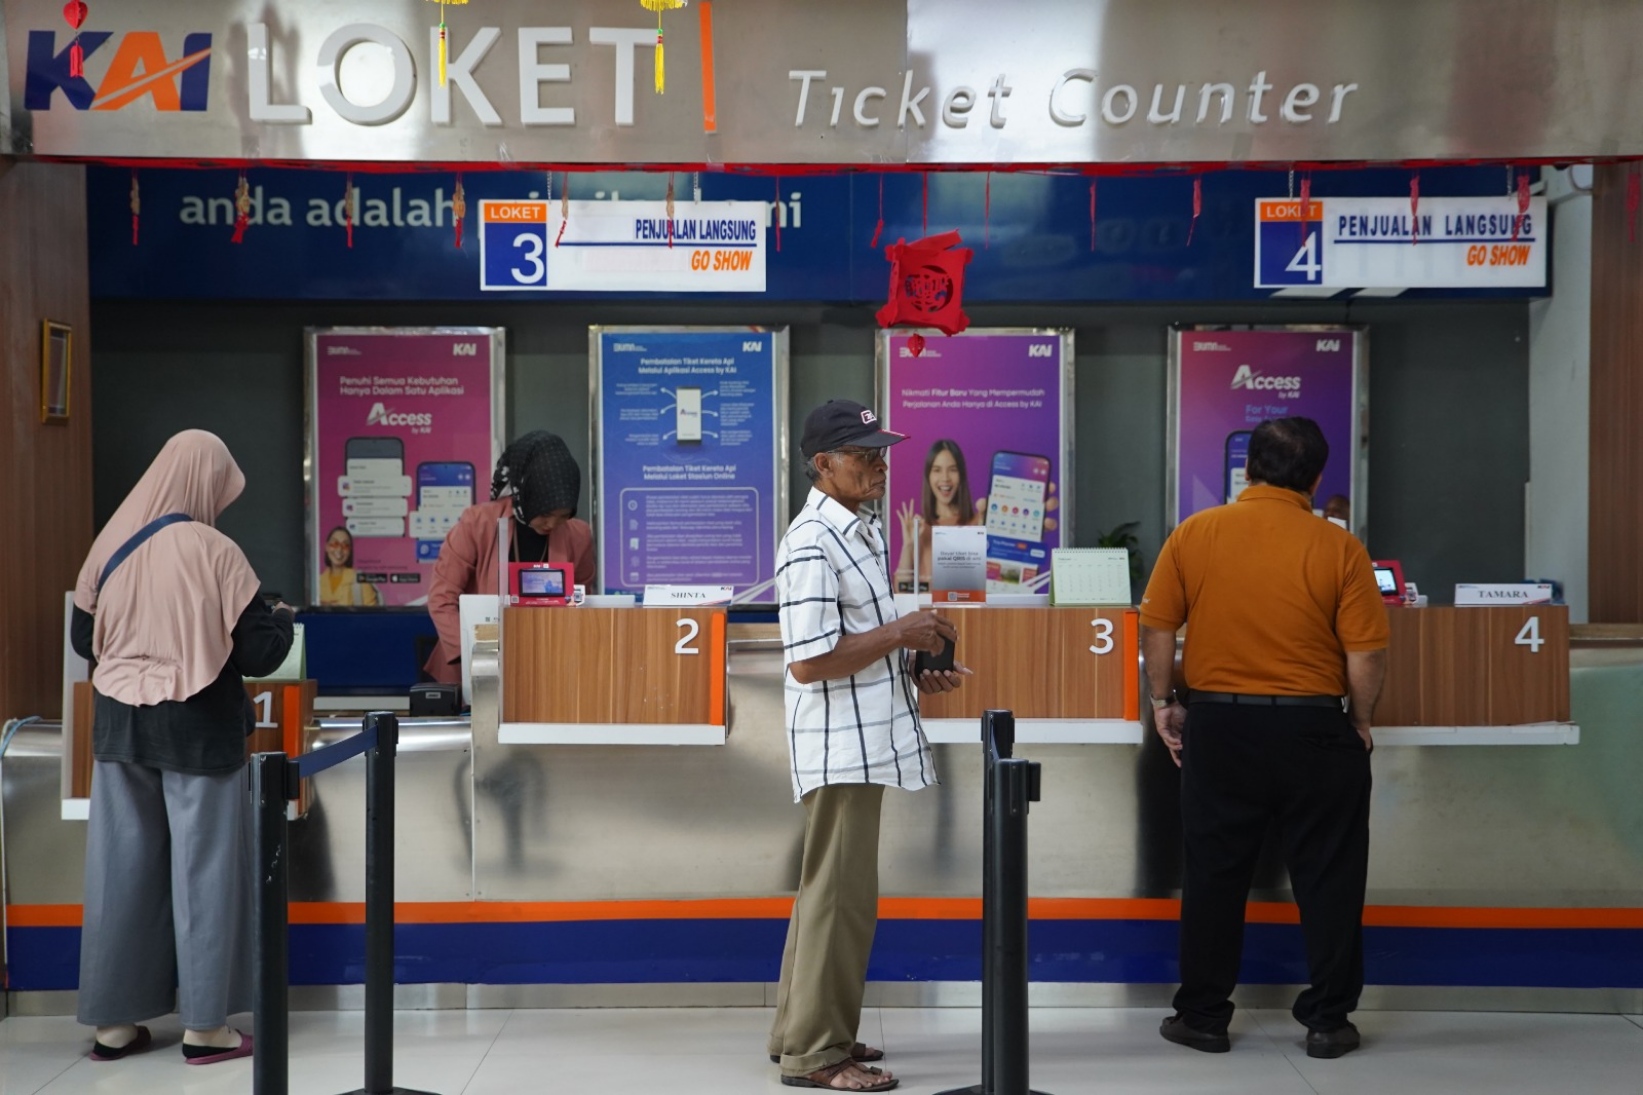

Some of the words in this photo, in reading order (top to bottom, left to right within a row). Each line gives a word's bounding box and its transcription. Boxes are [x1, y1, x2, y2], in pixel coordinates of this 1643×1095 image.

[24, 31, 213, 112] KAI
[247, 22, 664, 126] LOKET
[788, 69, 1012, 128] Ticket
[1047, 67, 1358, 128] Counter
[179, 185, 293, 226] anda
[305, 187, 459, 228] adalah
[490, 206, 541, 220] LOKET
[635, 218, 696, 240] PENJUALAN
[699, 219, 757, 241] LANGSUNG
[1338, 215, 1432, 236] PENJUALAN
[511, 232, 545, 284] 3
[691, 250, 710, 271] GO
[713, 250, 753, 271] SHOW
[1284, 231, 1322, 281] 4
[1467, 244, 1487, 266] GO
[1489, 244, 1531, 266] SHOW
[453, 343, 477, 356] KAI
[742, 341, 762, 352] KAI
[1028, 344, 1052, 357] KAI
[1316, 339, 1340, 352] KAI
[340, 376, 371, 385] Penuhi
[373, 376, 405, 385] Semua
[407, 376, 458, 385] Kebutuhan
[1231, 365, 1301, 390] Access
[340, 386, 370, 396] Hanya
[373, 386, 403, 395] Dalam
[405, 386, 426, 395] Satu
[428, 386, 464, 396] Aplikasi
[932, 389, 949, 397] Fitur
[950, 389, 967, 397] Baru
[968, 389, 988, 398] Yang
[367, 402, 432, 426] Access
[942, 400, 961, 408] Anda
[1245, 405, 1261, 413] For
[1264, 405, 1288, 414] Your
[1478, 590, 1529, 598] TAMARA
[674, 617, 699, 654] 2
[1089, 618, 1114, 655] 3
[1514, 616, 1545, 653] 4
[253, 691, 278, 728] 1
